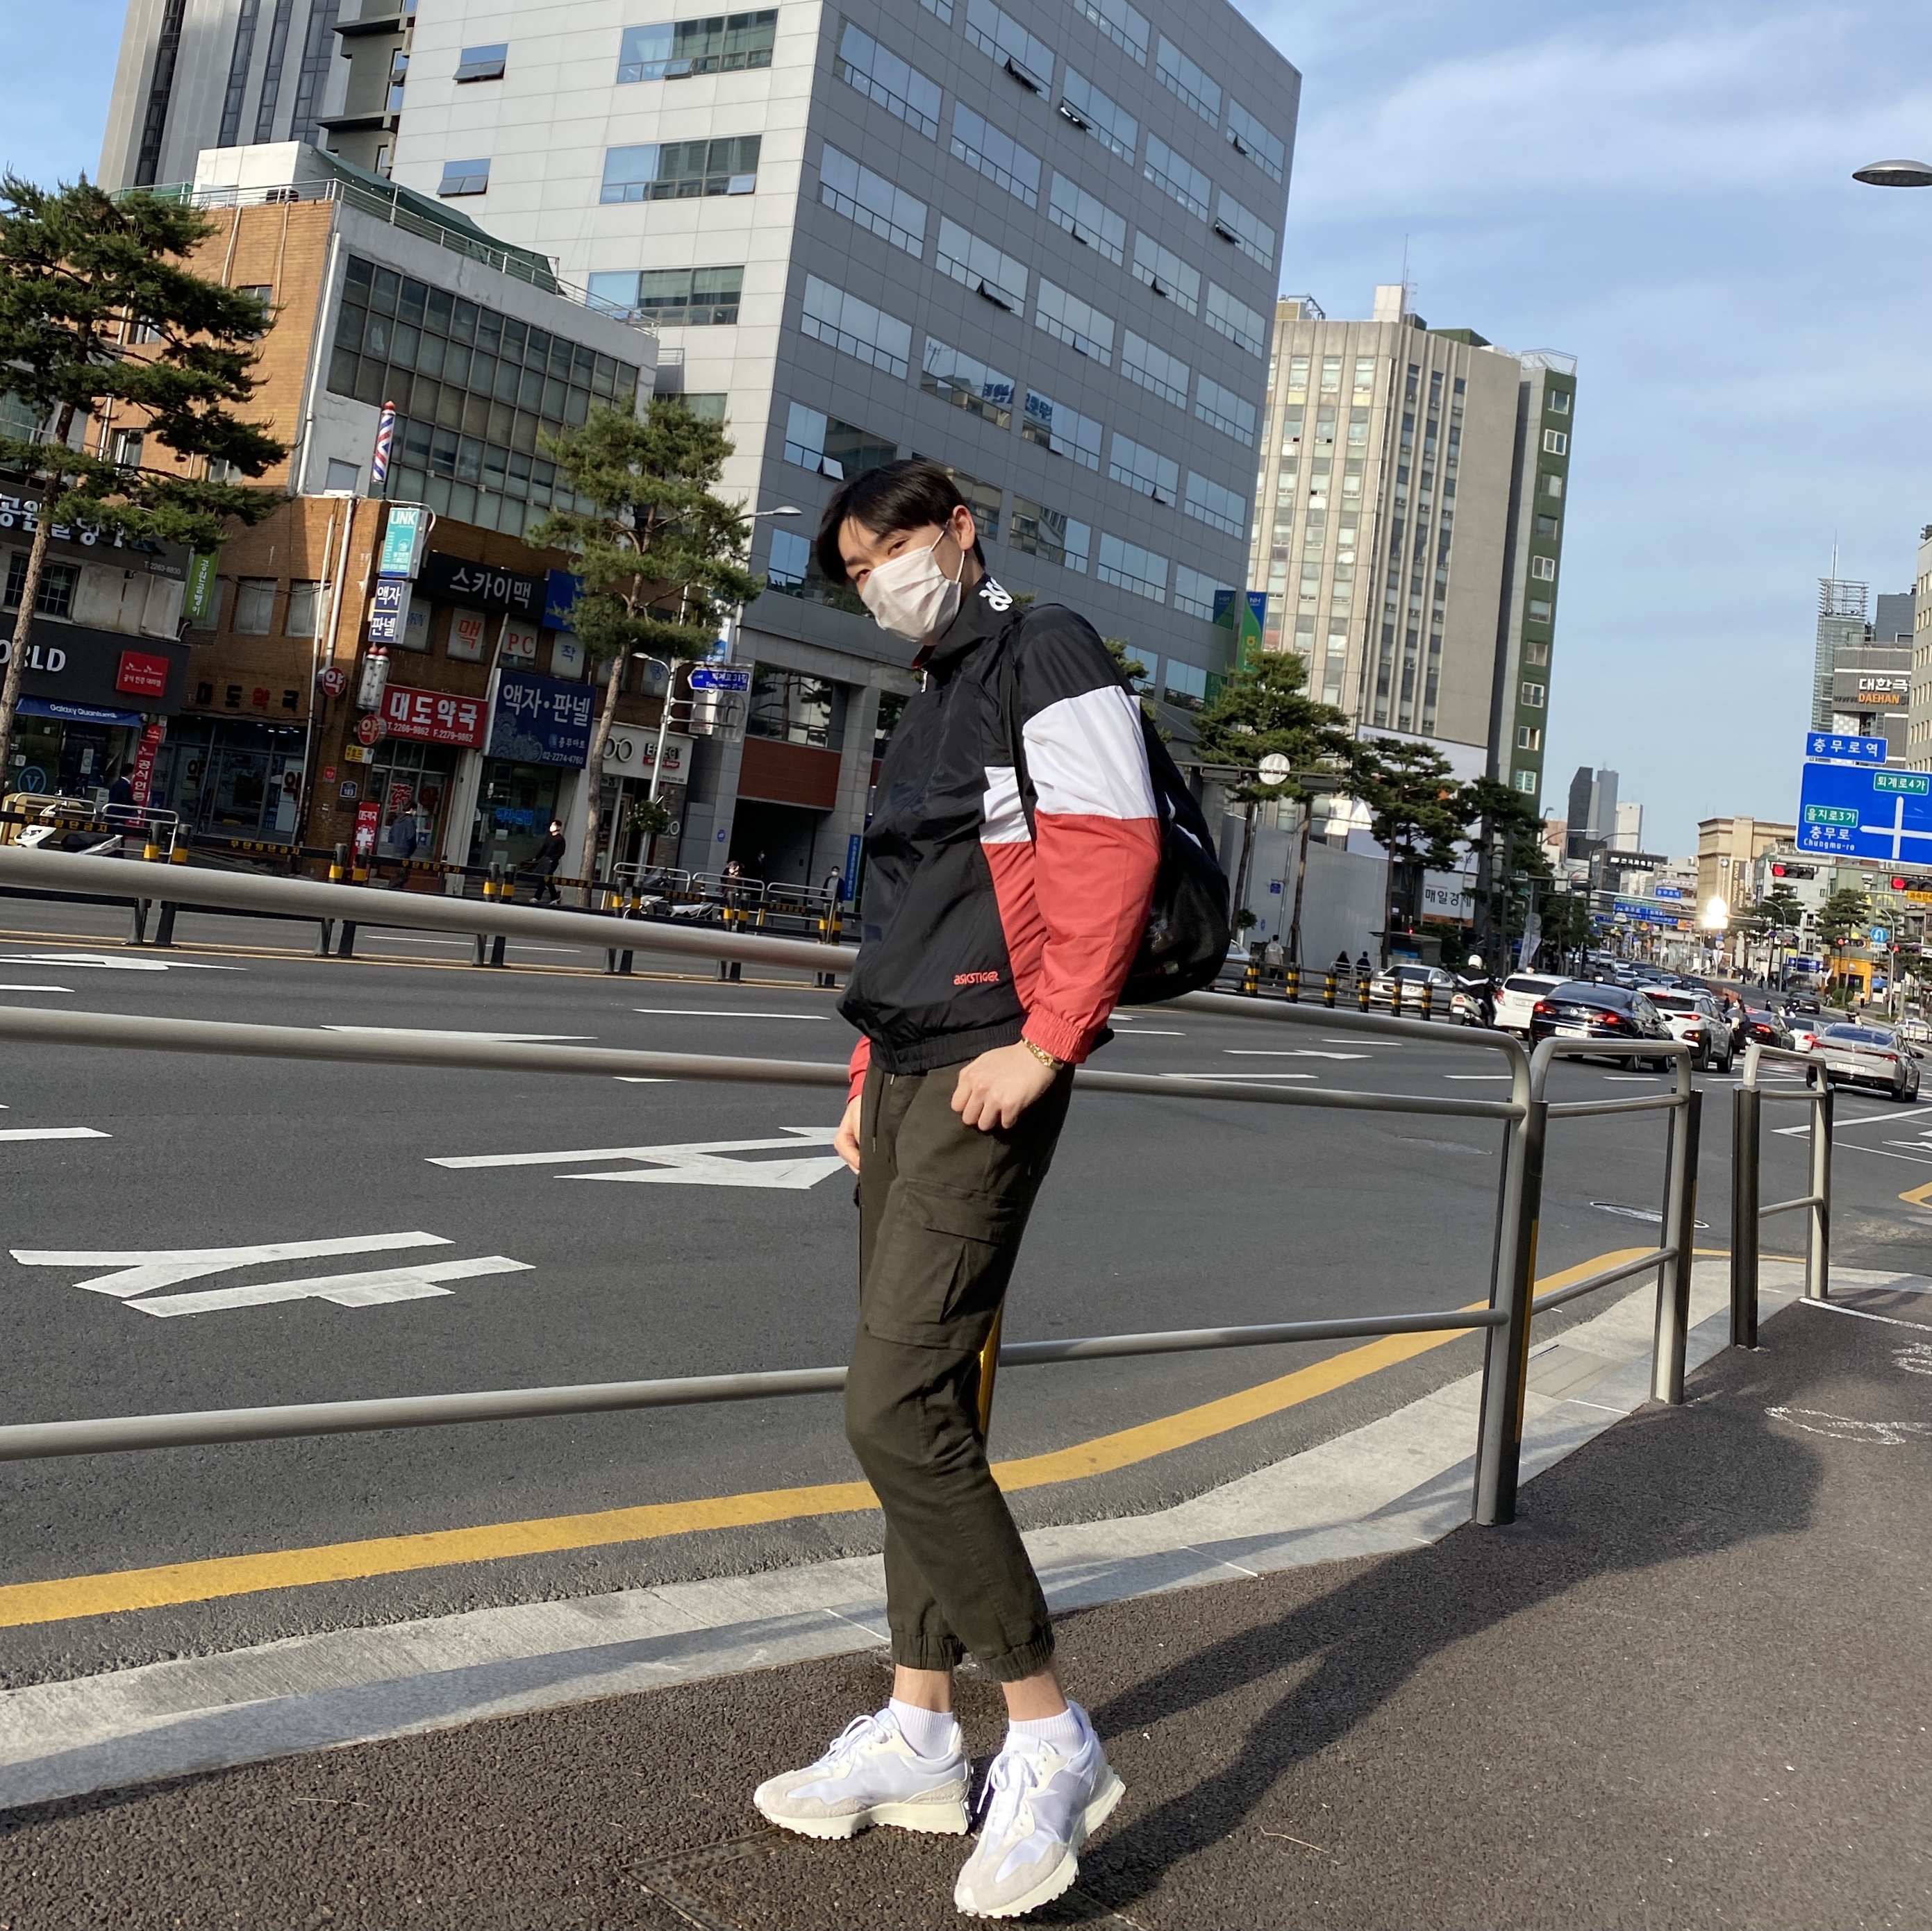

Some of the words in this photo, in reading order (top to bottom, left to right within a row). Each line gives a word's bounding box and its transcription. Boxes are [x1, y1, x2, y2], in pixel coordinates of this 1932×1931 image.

[377, 586, 401, 605] 액자
[450, 567, 532, 609] 스카이맥
[371, 617, 396, 637] 판넬
[458, 619, 483, 650] 맥
[326, 671, 344, 693] 약
[1859, 678, 1910, 692] 대한극
[50, 704, 77, 715] Galaxy
[390, 692, 477, 731] 대도약국
[1813, 738, 1879, 758] 충무로역
[1877, 776, 1925, 791] 퇴계로4가
[1808, 808, 1856, 824] 을지로3가
[1810, 826, 1850, 840] 충무로
[1804, 837, 1855, 851] Chungmu-ro
